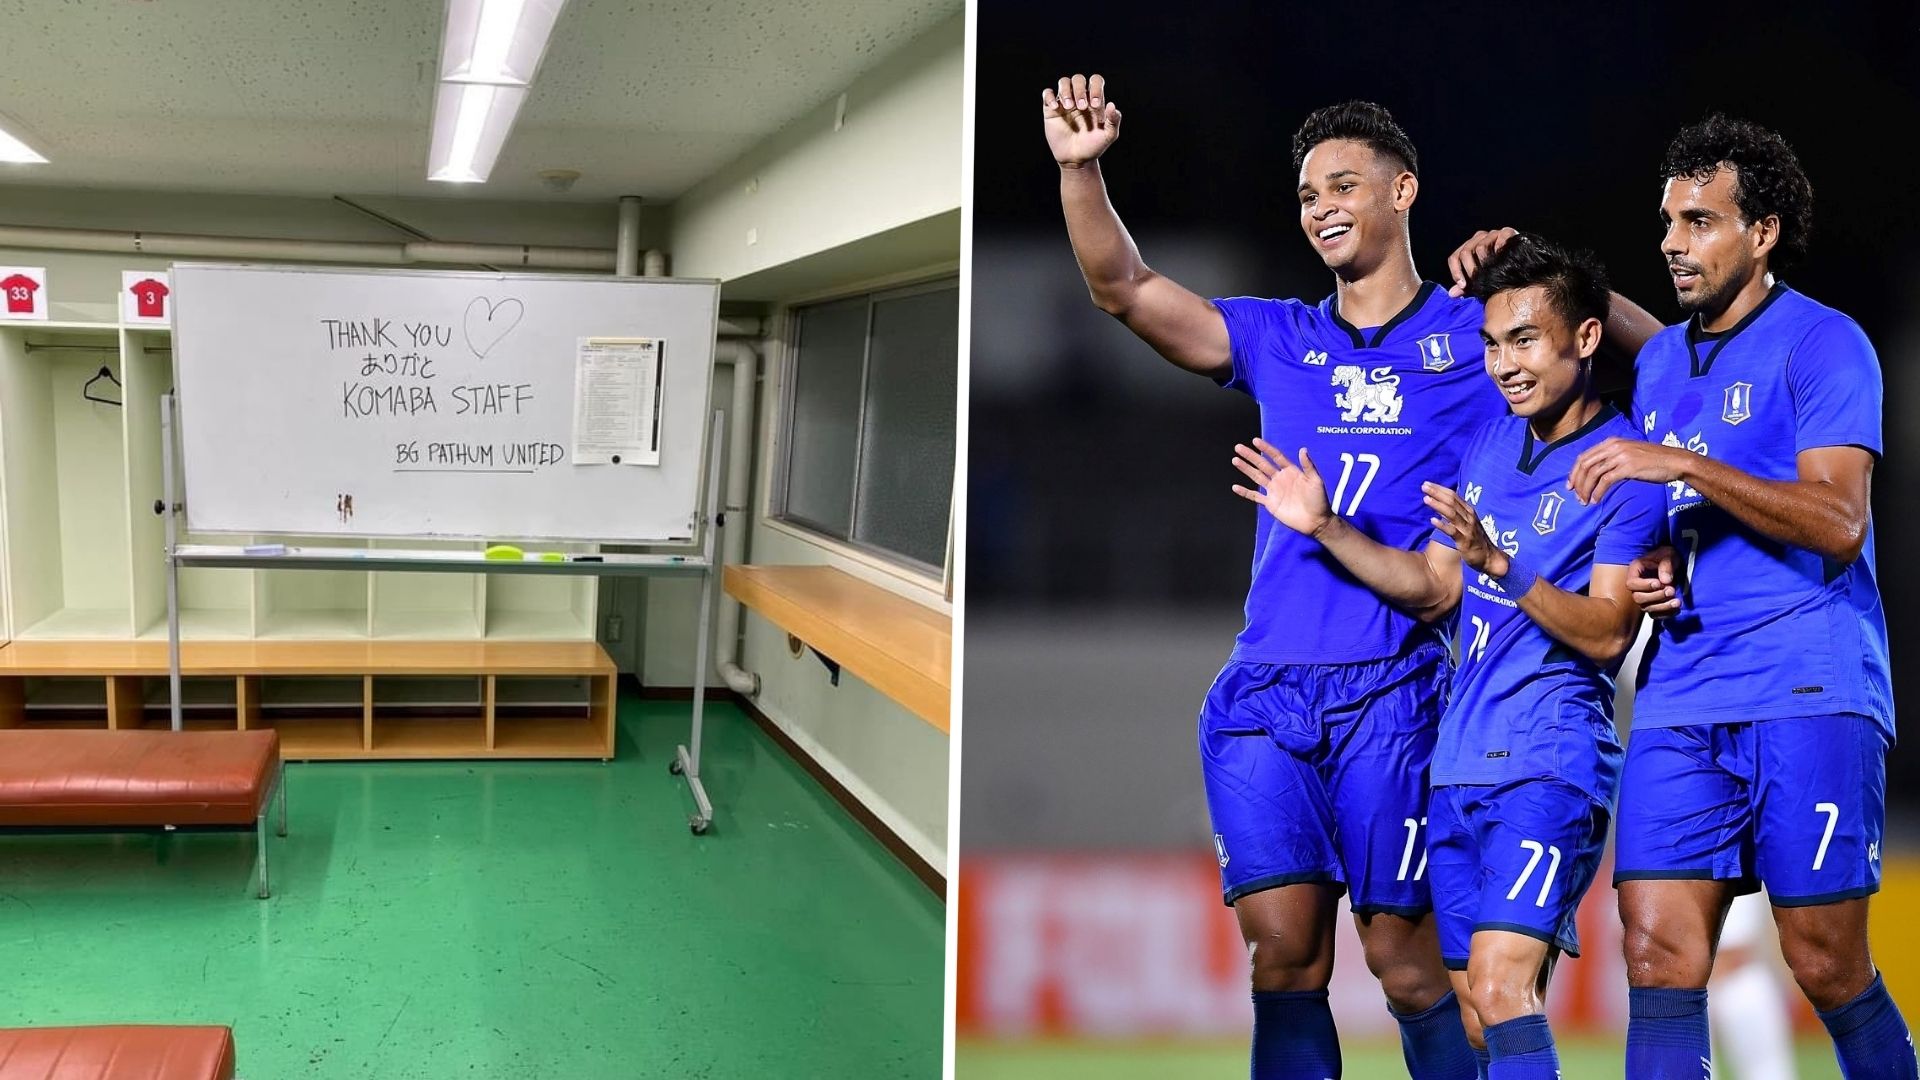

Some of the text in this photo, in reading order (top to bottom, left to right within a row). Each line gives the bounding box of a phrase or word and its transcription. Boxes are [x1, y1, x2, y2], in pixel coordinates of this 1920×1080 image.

[11, 286, 29, 300] 33
[146, 291, 155, 304] 3
[320, 318, 451, 350] THANK YOU
[343, 381, 534, 418] KOMABA STAFF
[1316, 426, 1412, 435] SINGHA CORPORATION
[396, 441, 564, 467] BG PATHUM UNITED
[1331, 452, 1381, 517] 17
[1812, 802, 1840, 871] 7
[1506, 839, 1562, 907] 71
